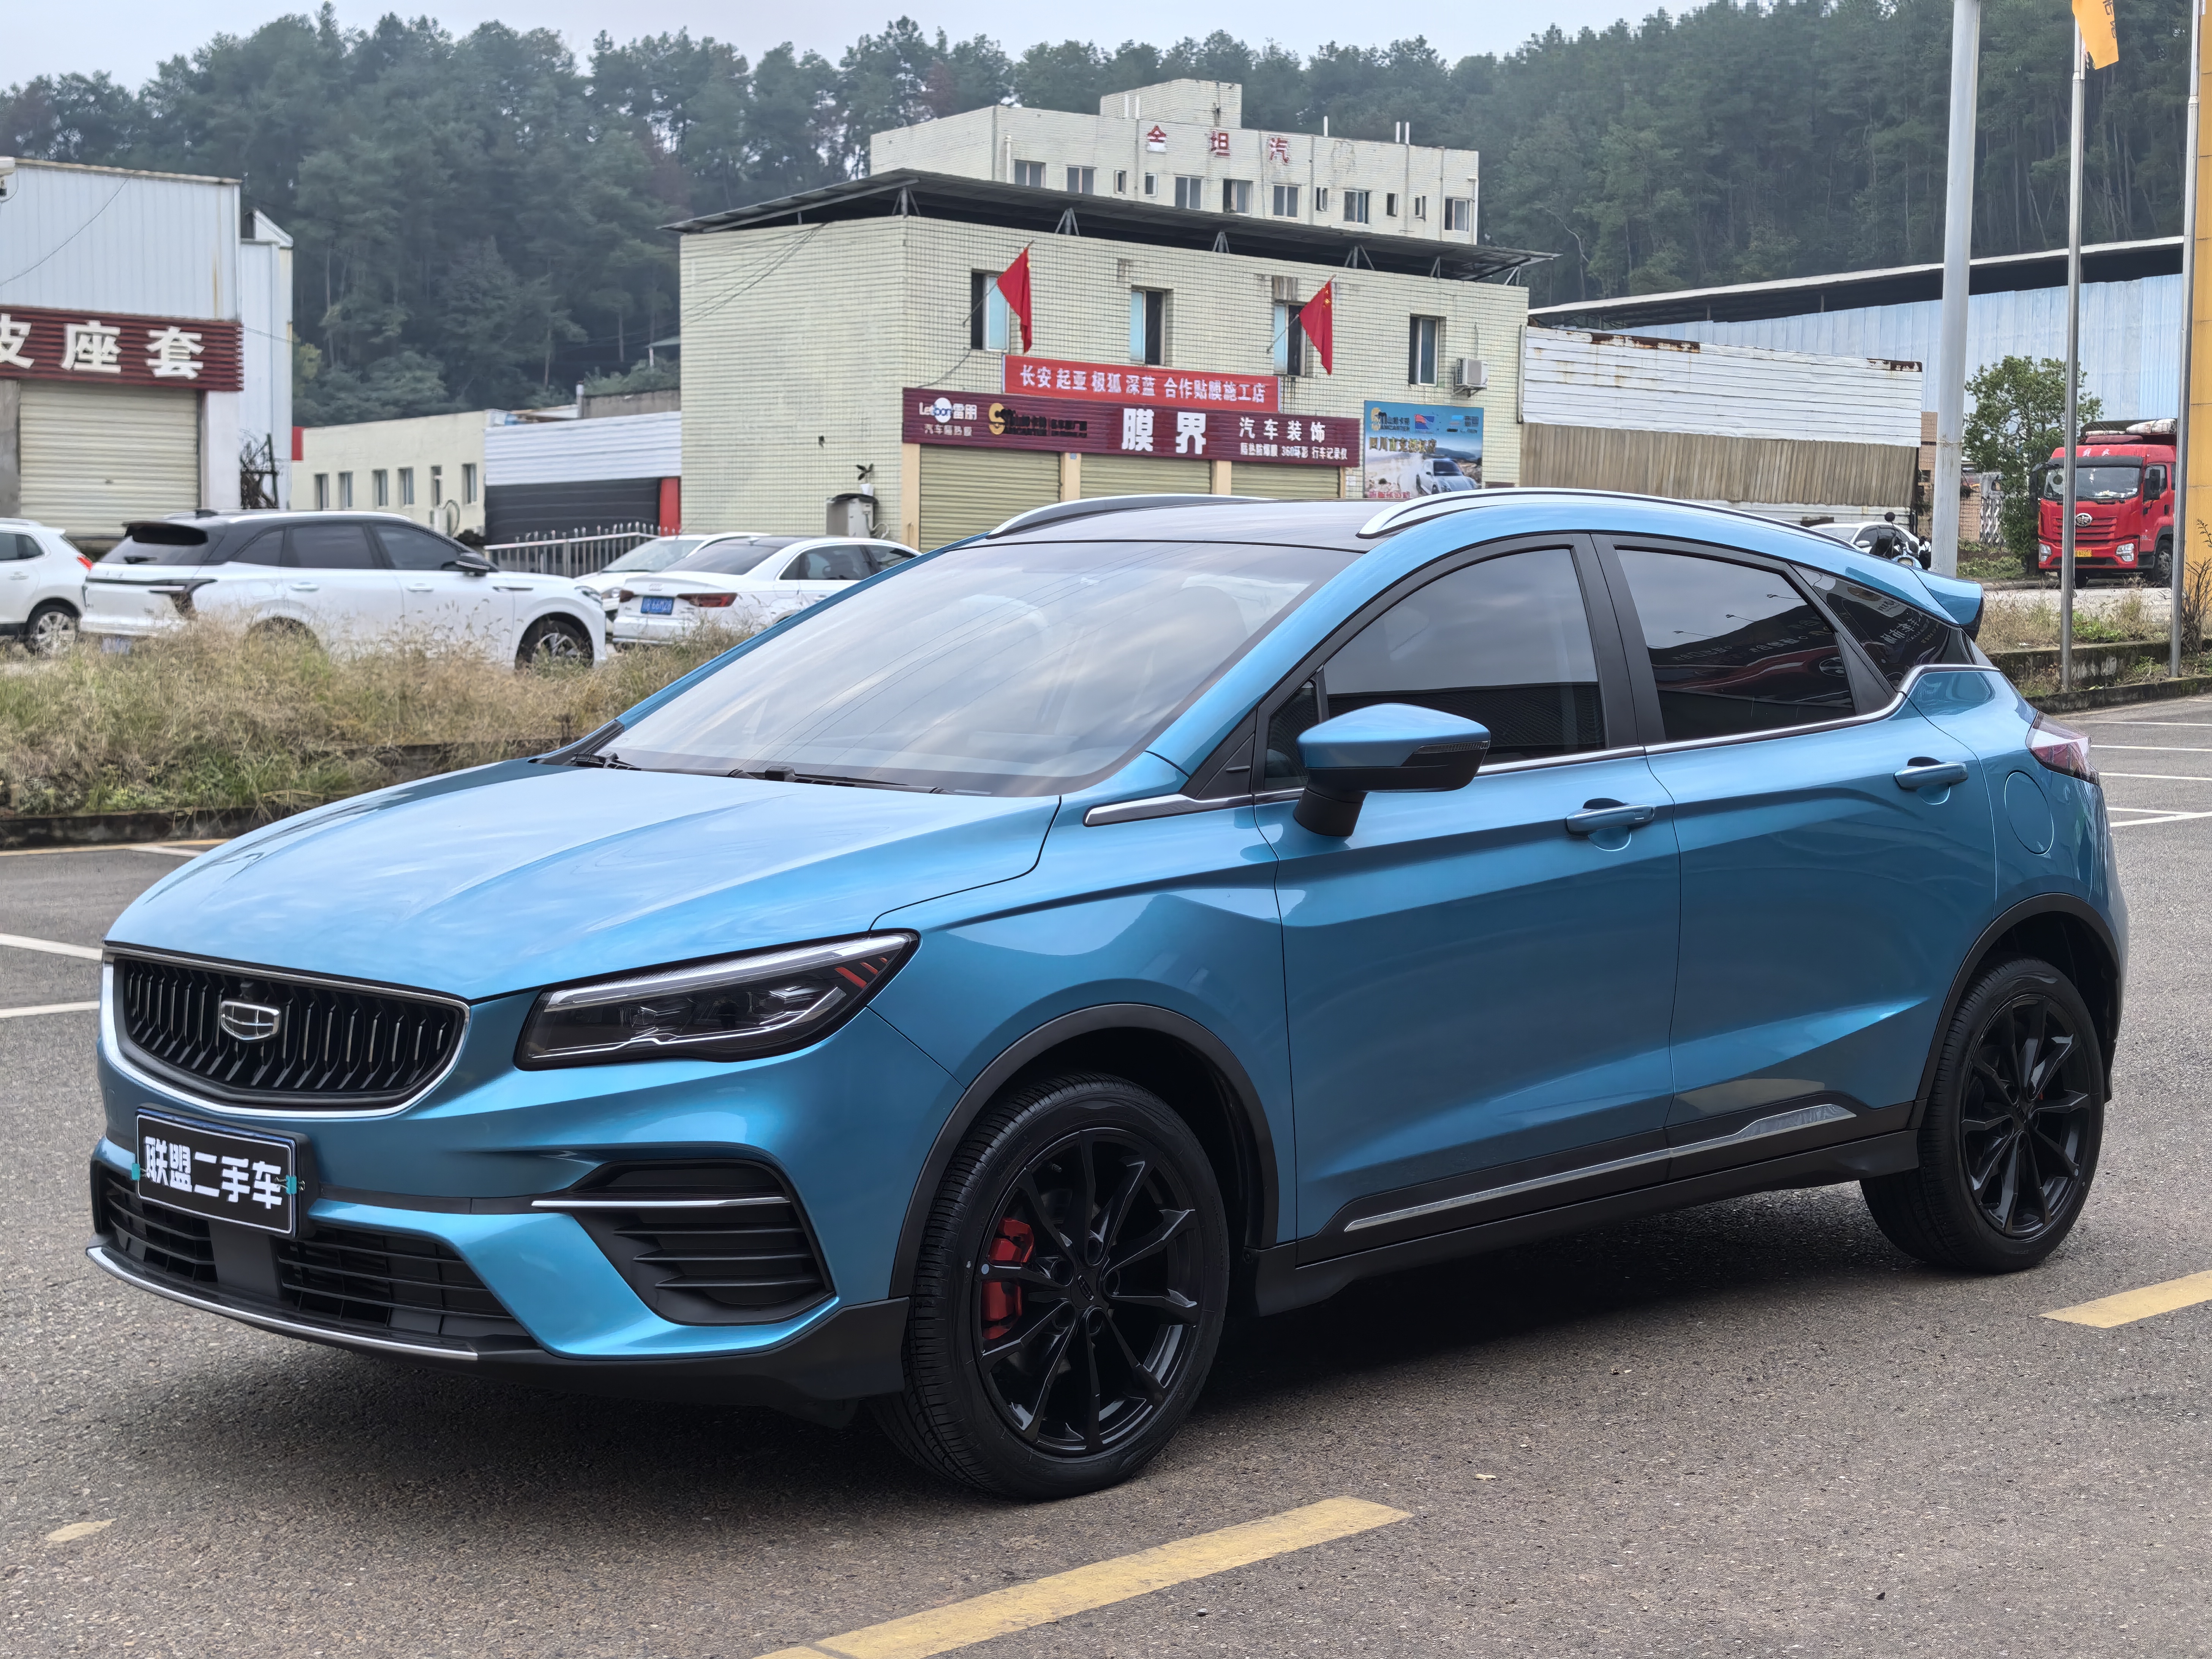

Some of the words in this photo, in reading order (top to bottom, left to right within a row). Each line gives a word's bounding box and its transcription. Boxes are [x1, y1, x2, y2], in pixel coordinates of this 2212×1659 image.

[1020, 365, 1051, 388] 长安
[1057, 368, 1087, 390] 起亚
[1126, 374, 1156, 396] 深蓝
[1164, 377, 1266, 403] 合作贴膜施工店
[1122, 408, 1206, 454] 膜界
[1239, 416, 1326, 443] 汽车装饰
[144, 1136, 282, 1209] 联盟二手车
